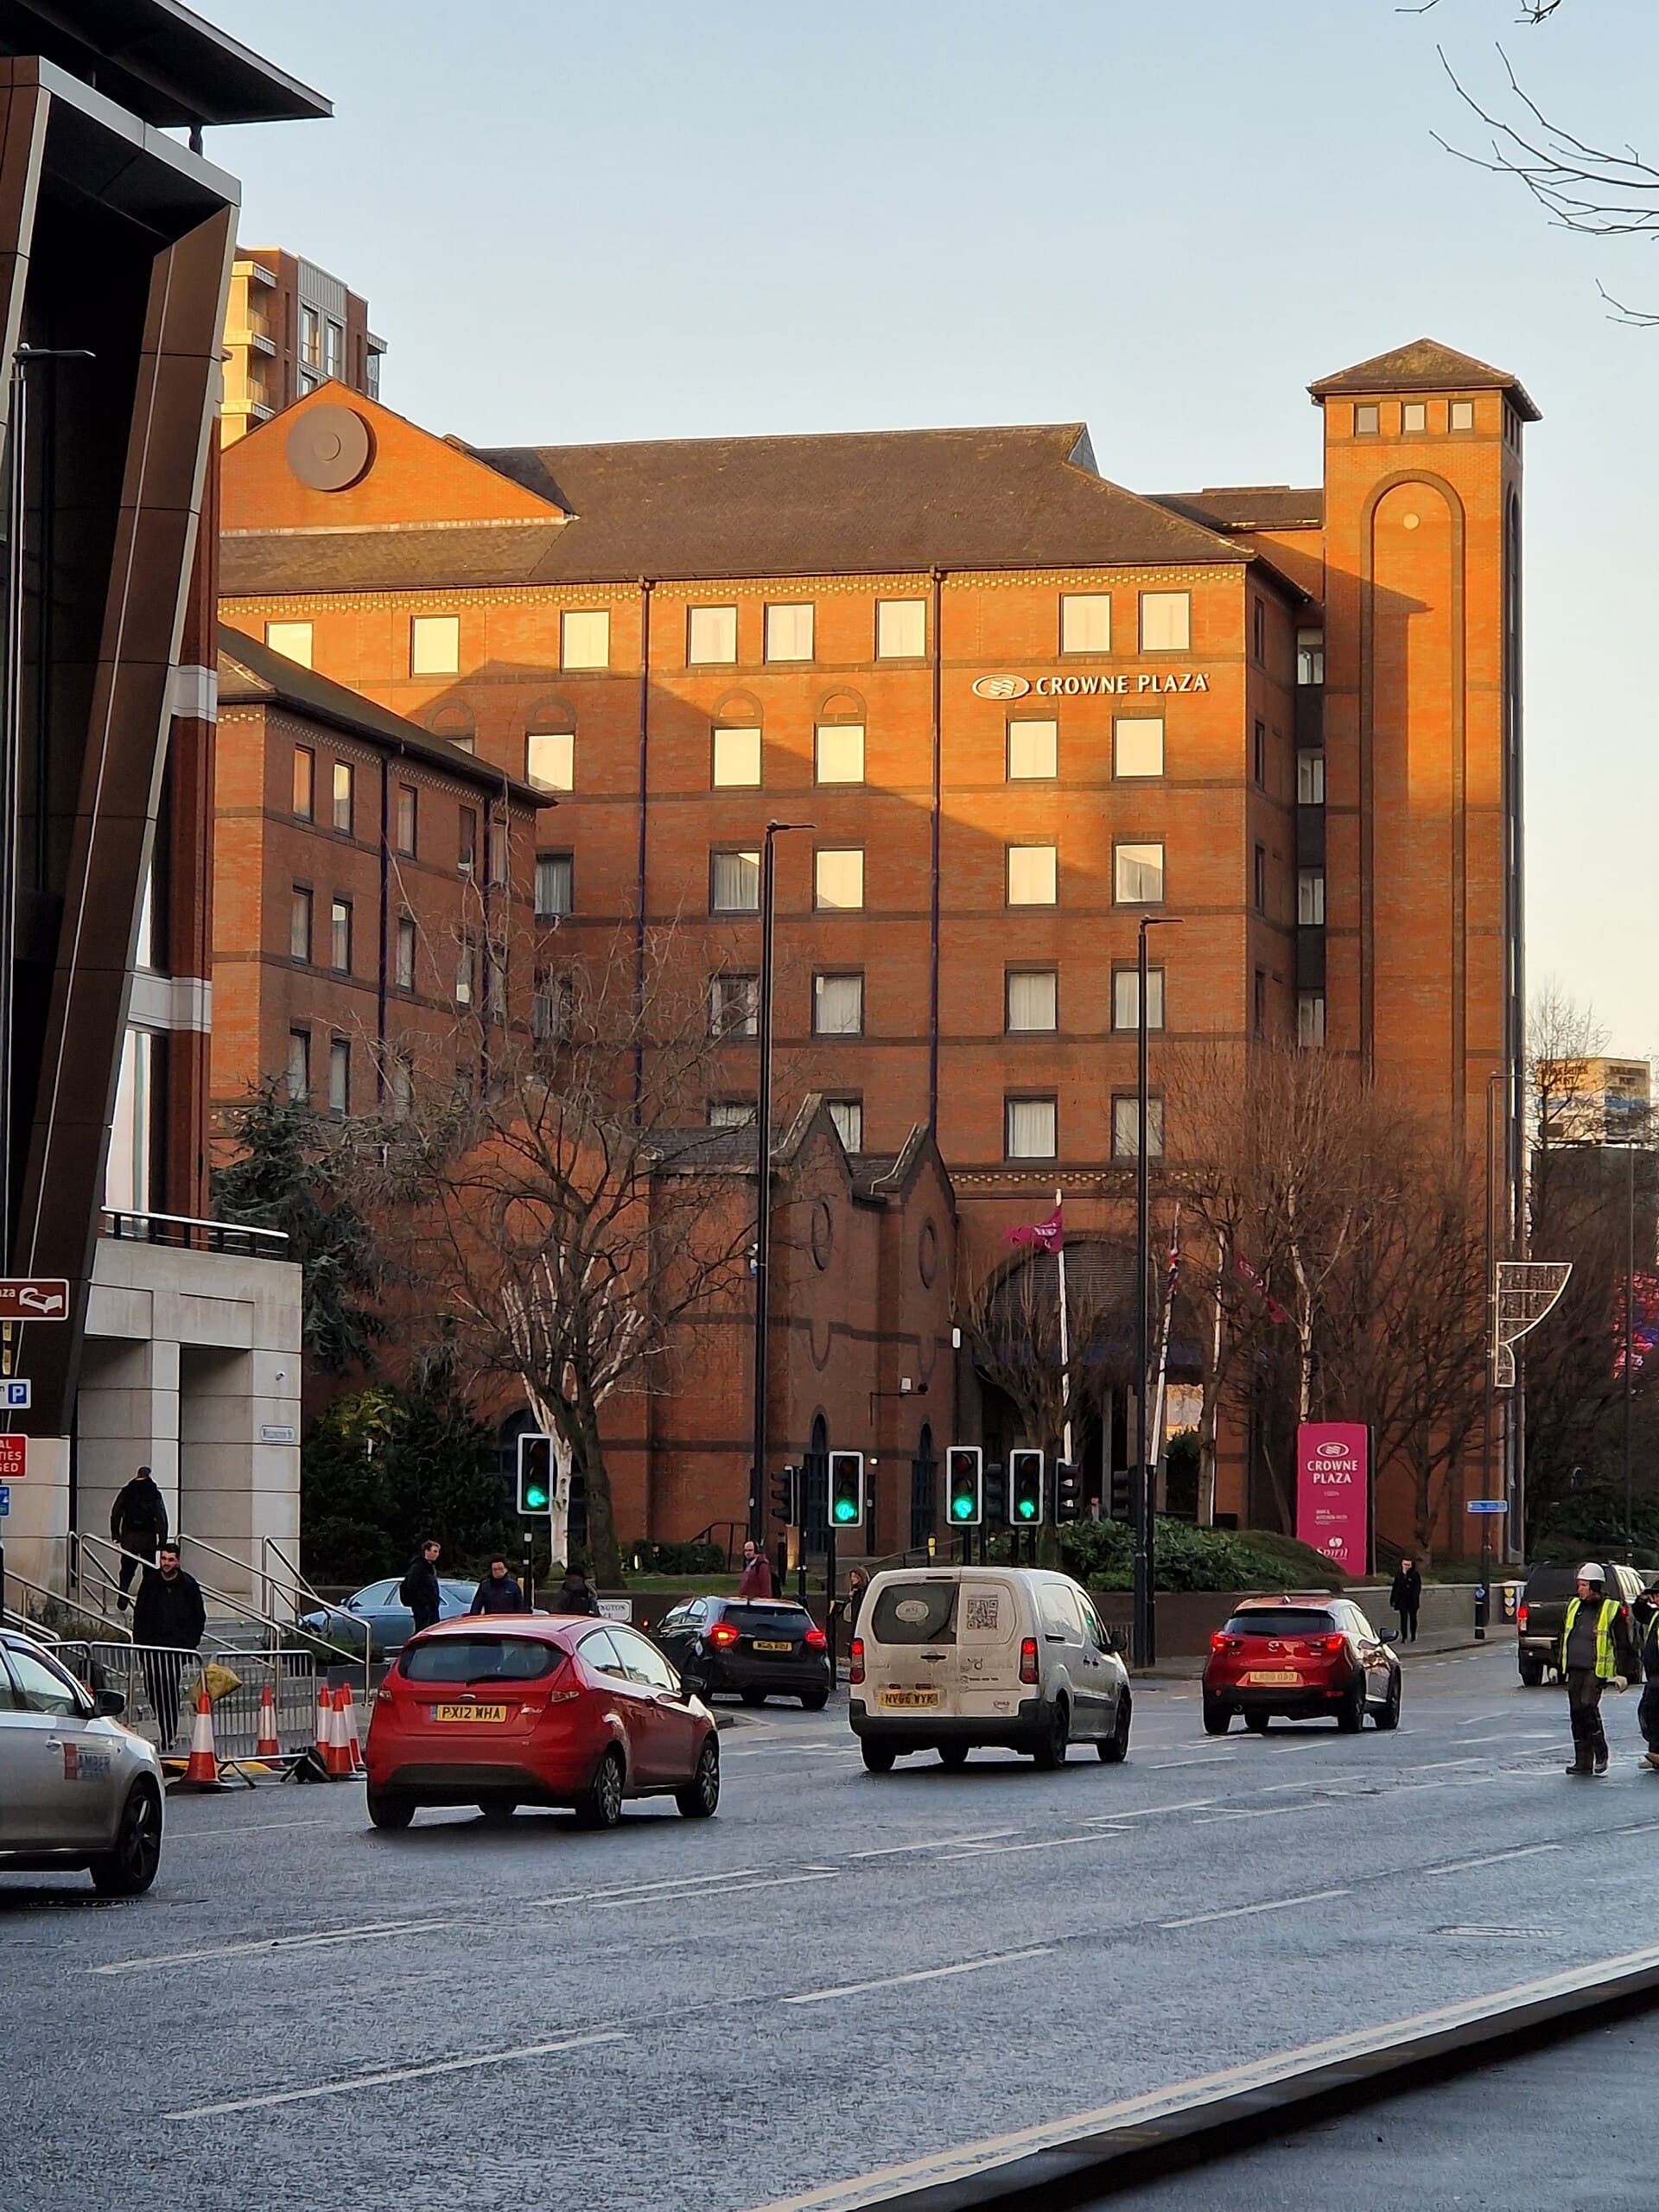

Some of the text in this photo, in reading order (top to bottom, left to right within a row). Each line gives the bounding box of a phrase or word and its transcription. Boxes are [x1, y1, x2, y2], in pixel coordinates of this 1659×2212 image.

[1036, 673, 1207, 696] CROWNE PLAZA
[1307, 1460, 1358, 1471] CROWNE
[1313, 1472, 1351, 1484] PLAZA
[475, 1707, 500, 1719] WHA
